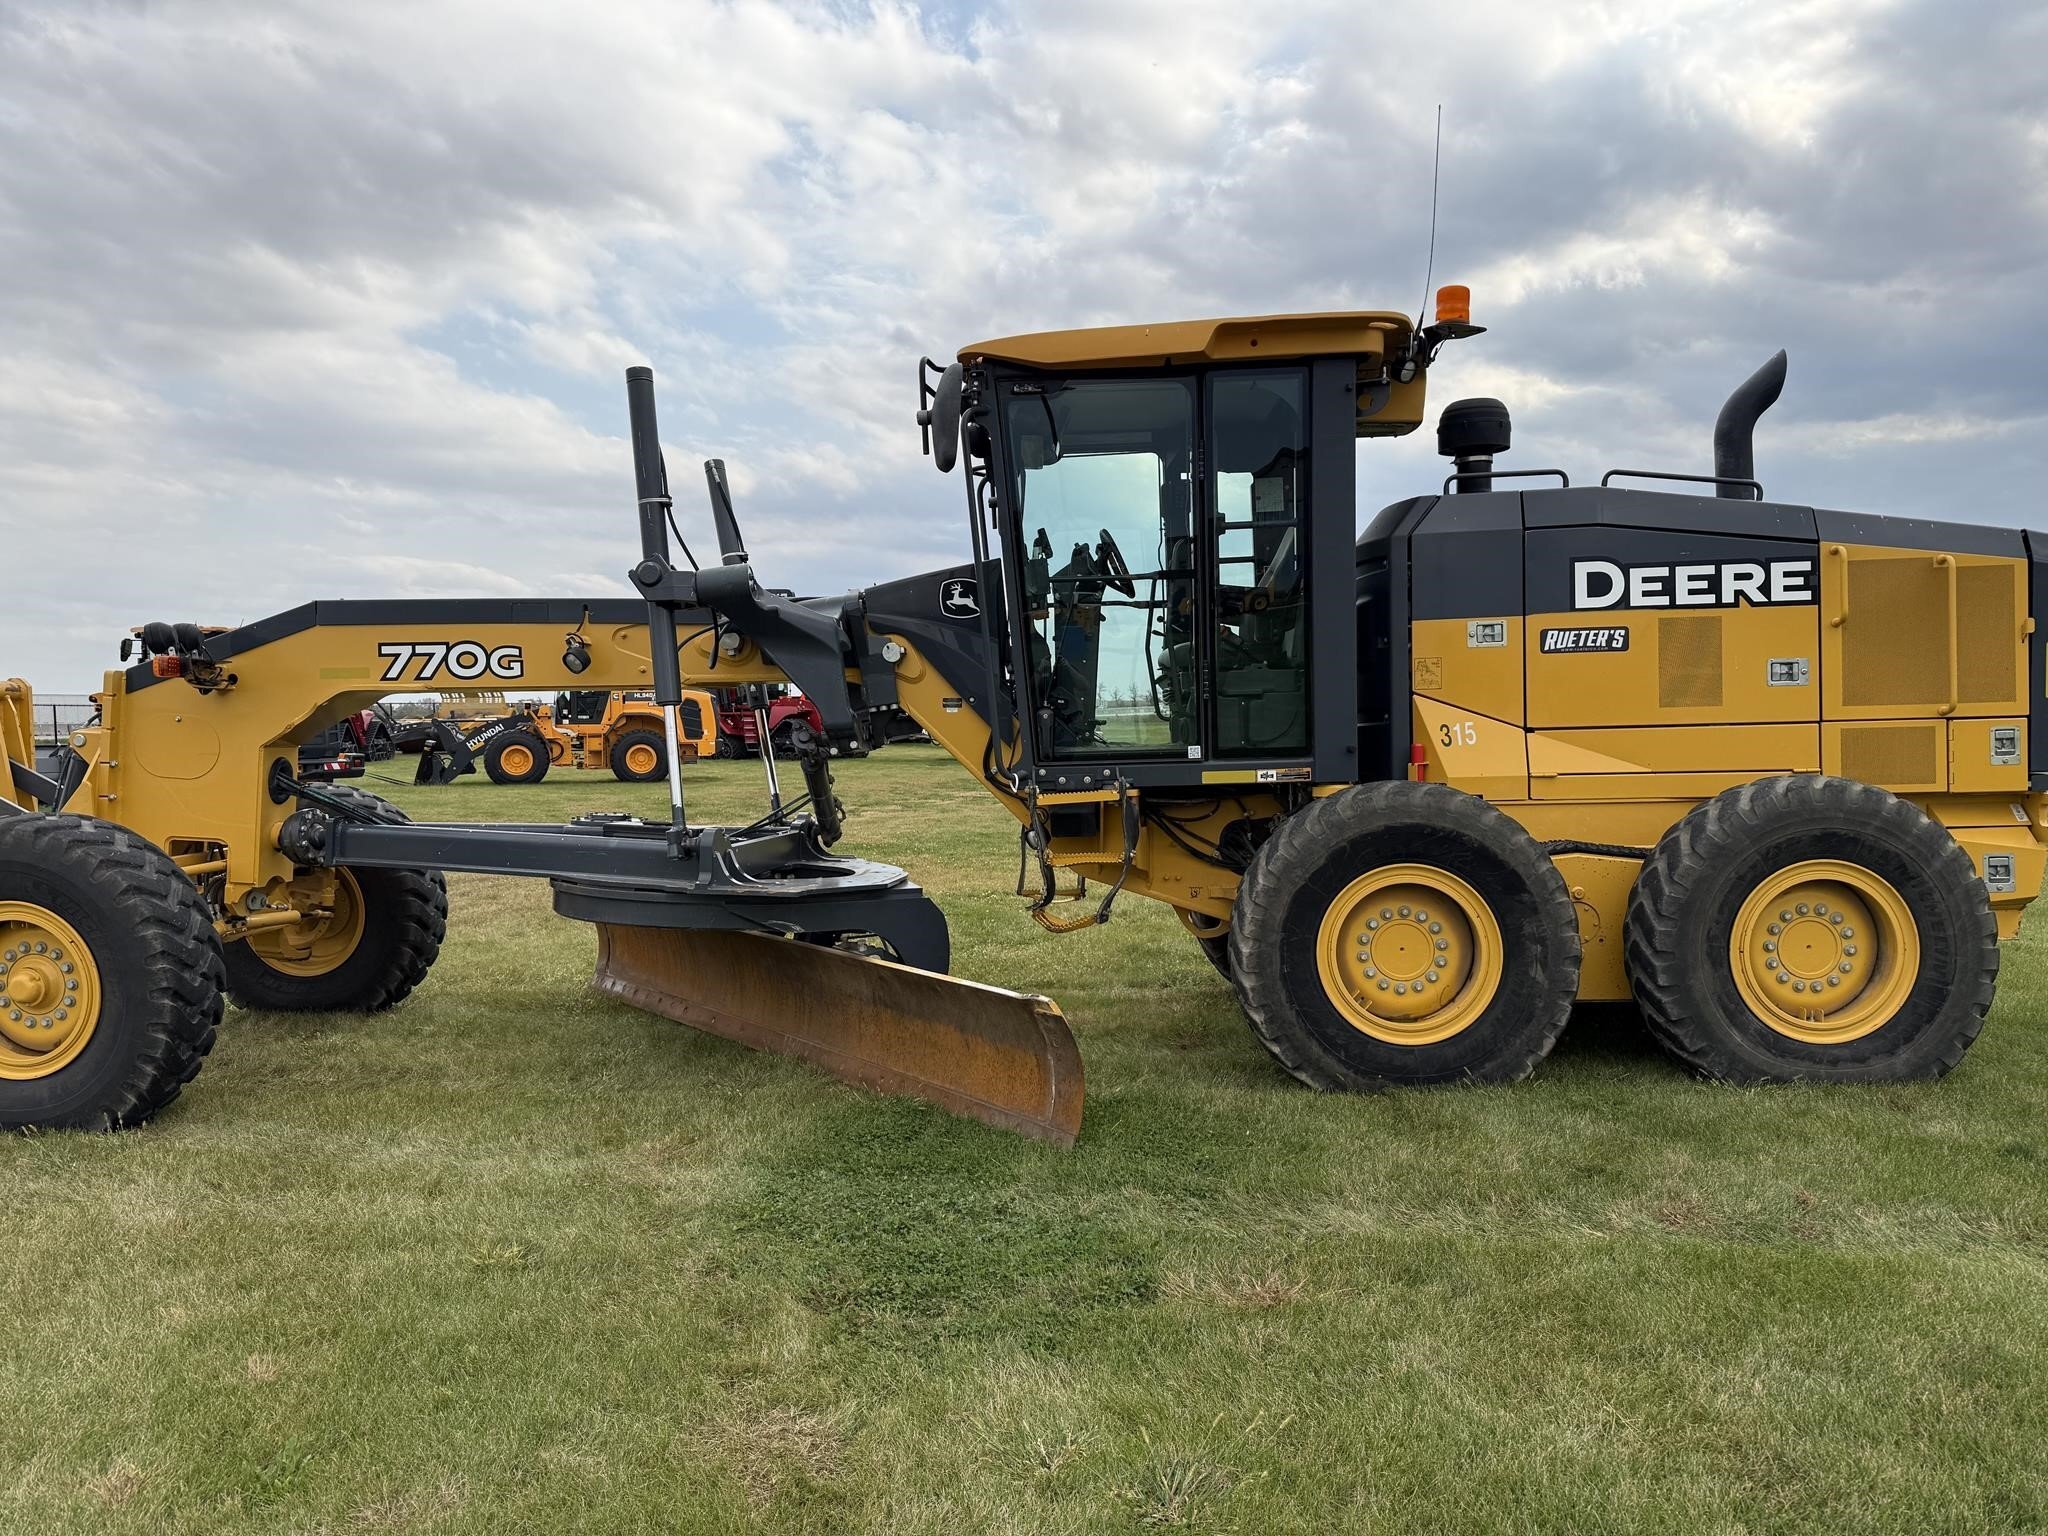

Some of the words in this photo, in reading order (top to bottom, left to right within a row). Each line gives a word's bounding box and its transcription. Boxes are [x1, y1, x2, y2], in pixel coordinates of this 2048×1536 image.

[1574, 560, 1812, 609] DEERE
[1544, 629, 1625, 651] RUETER'S
[378, 640, 523, 681] 770G
[465, 723, 505, 752] HYUNDAI
[1440, 721, 1477, 747] 315
